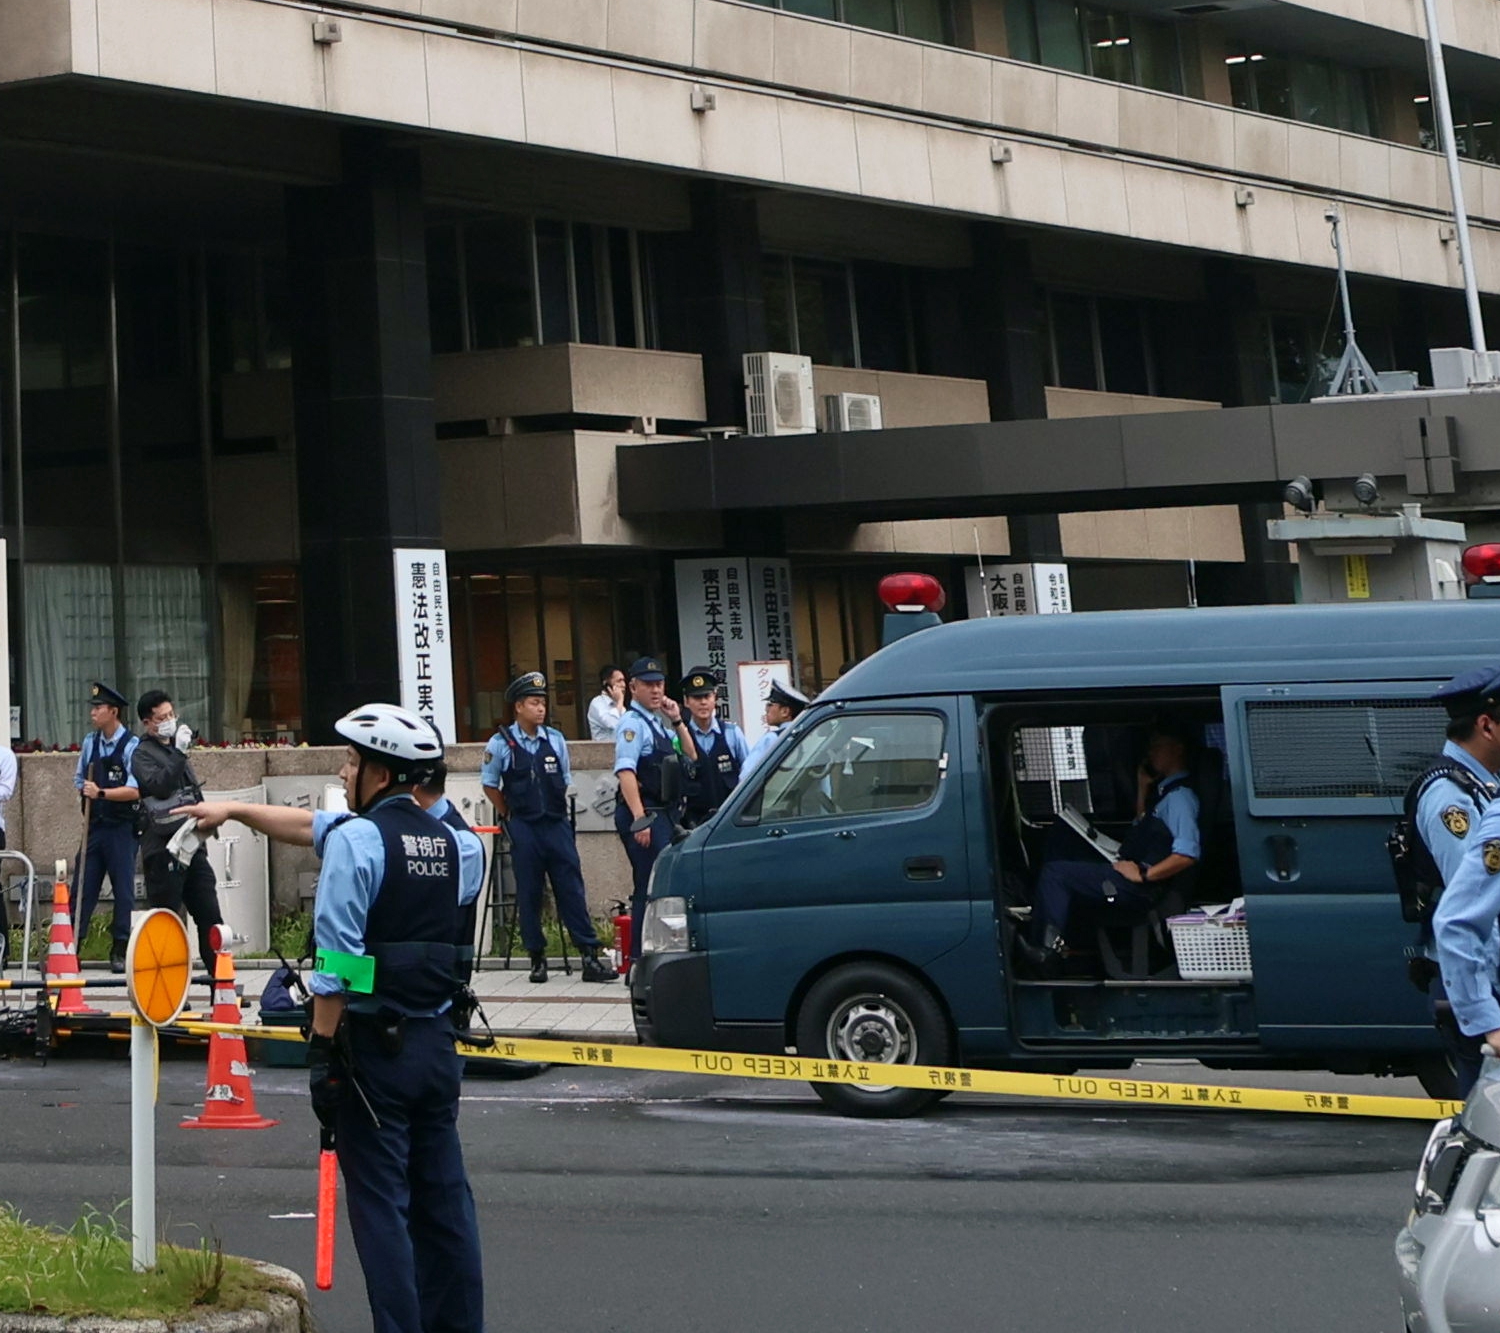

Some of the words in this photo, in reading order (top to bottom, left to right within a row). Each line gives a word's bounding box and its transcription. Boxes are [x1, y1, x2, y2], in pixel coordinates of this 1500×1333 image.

[431, 561, 445, 643] 自由民主党
[726, 567, 744, 640] 自由民主党
[370, 735, 399, 752] 警視庁
[401, 834, 448, 858] 警視庁
[407, 859, 449, 877] POLICE
